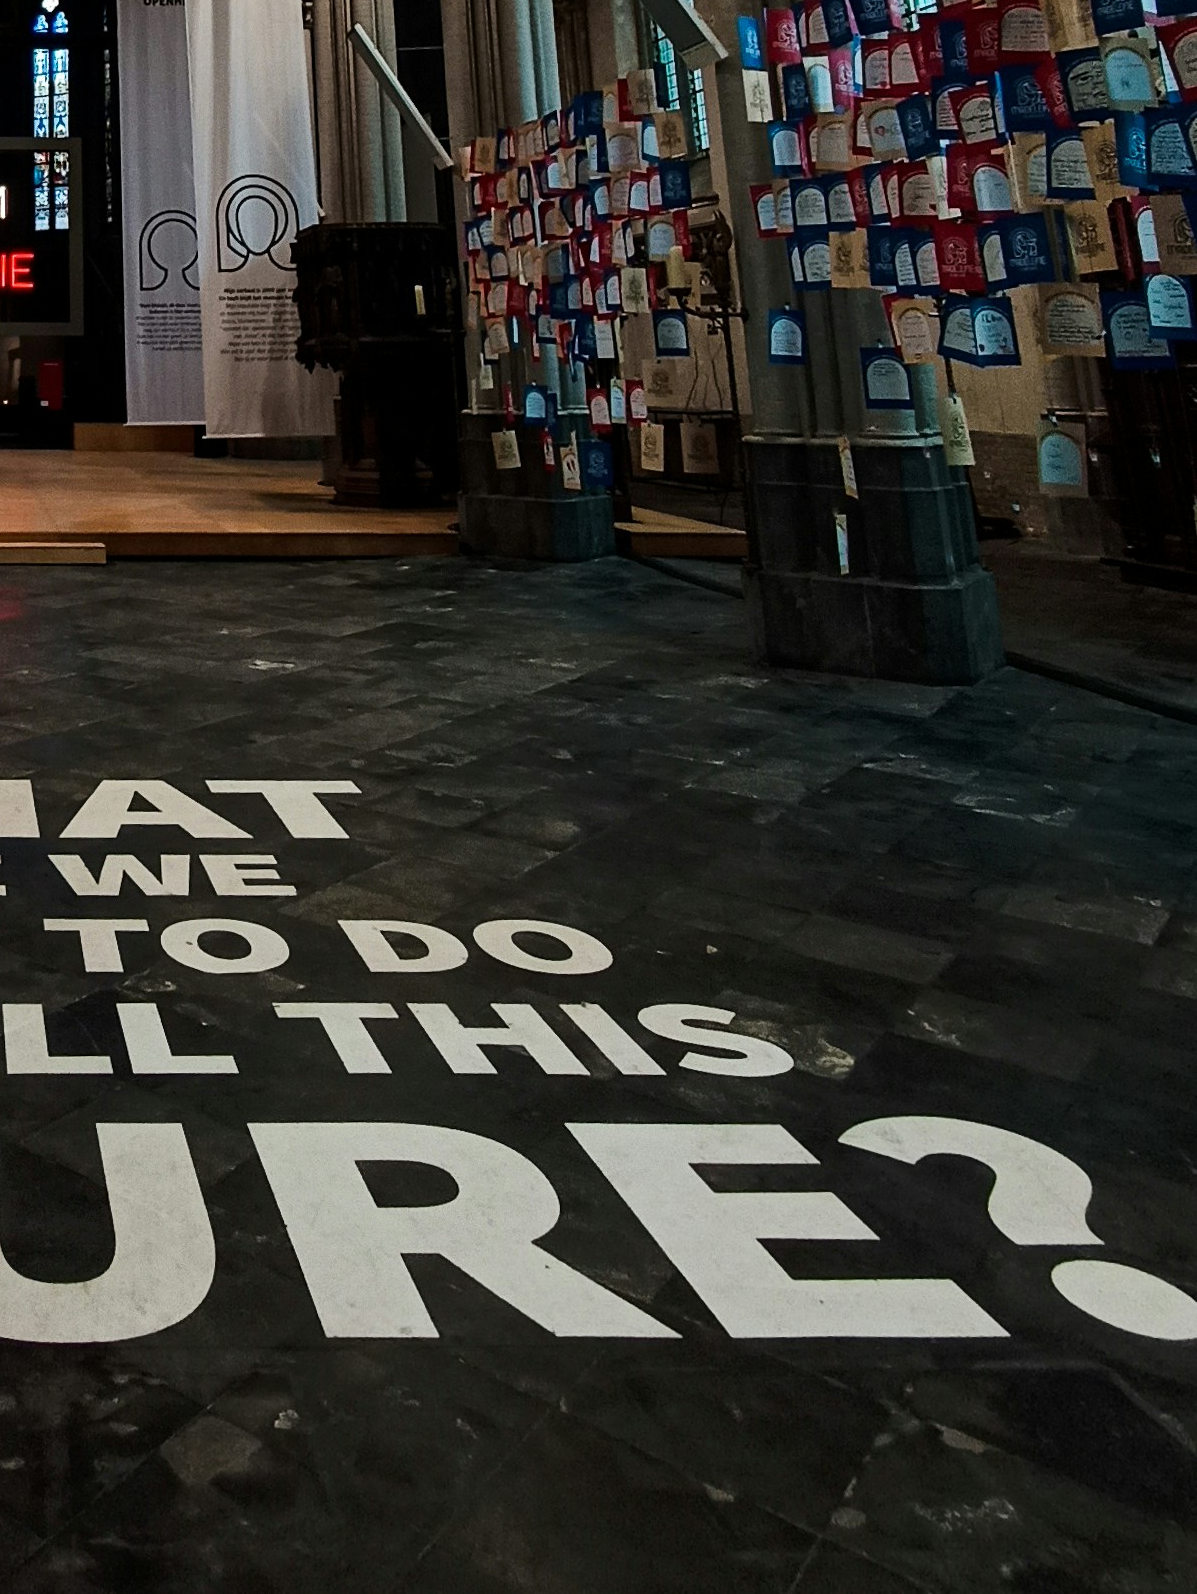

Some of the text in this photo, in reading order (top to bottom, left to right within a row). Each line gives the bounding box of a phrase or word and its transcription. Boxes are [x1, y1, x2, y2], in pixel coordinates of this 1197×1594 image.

[48, 853, 298, 897] WE
[43, 917, 290, 975] TO
[337, 918, 614, 975] DO
[272, 1002, 795, 1078] THIS
